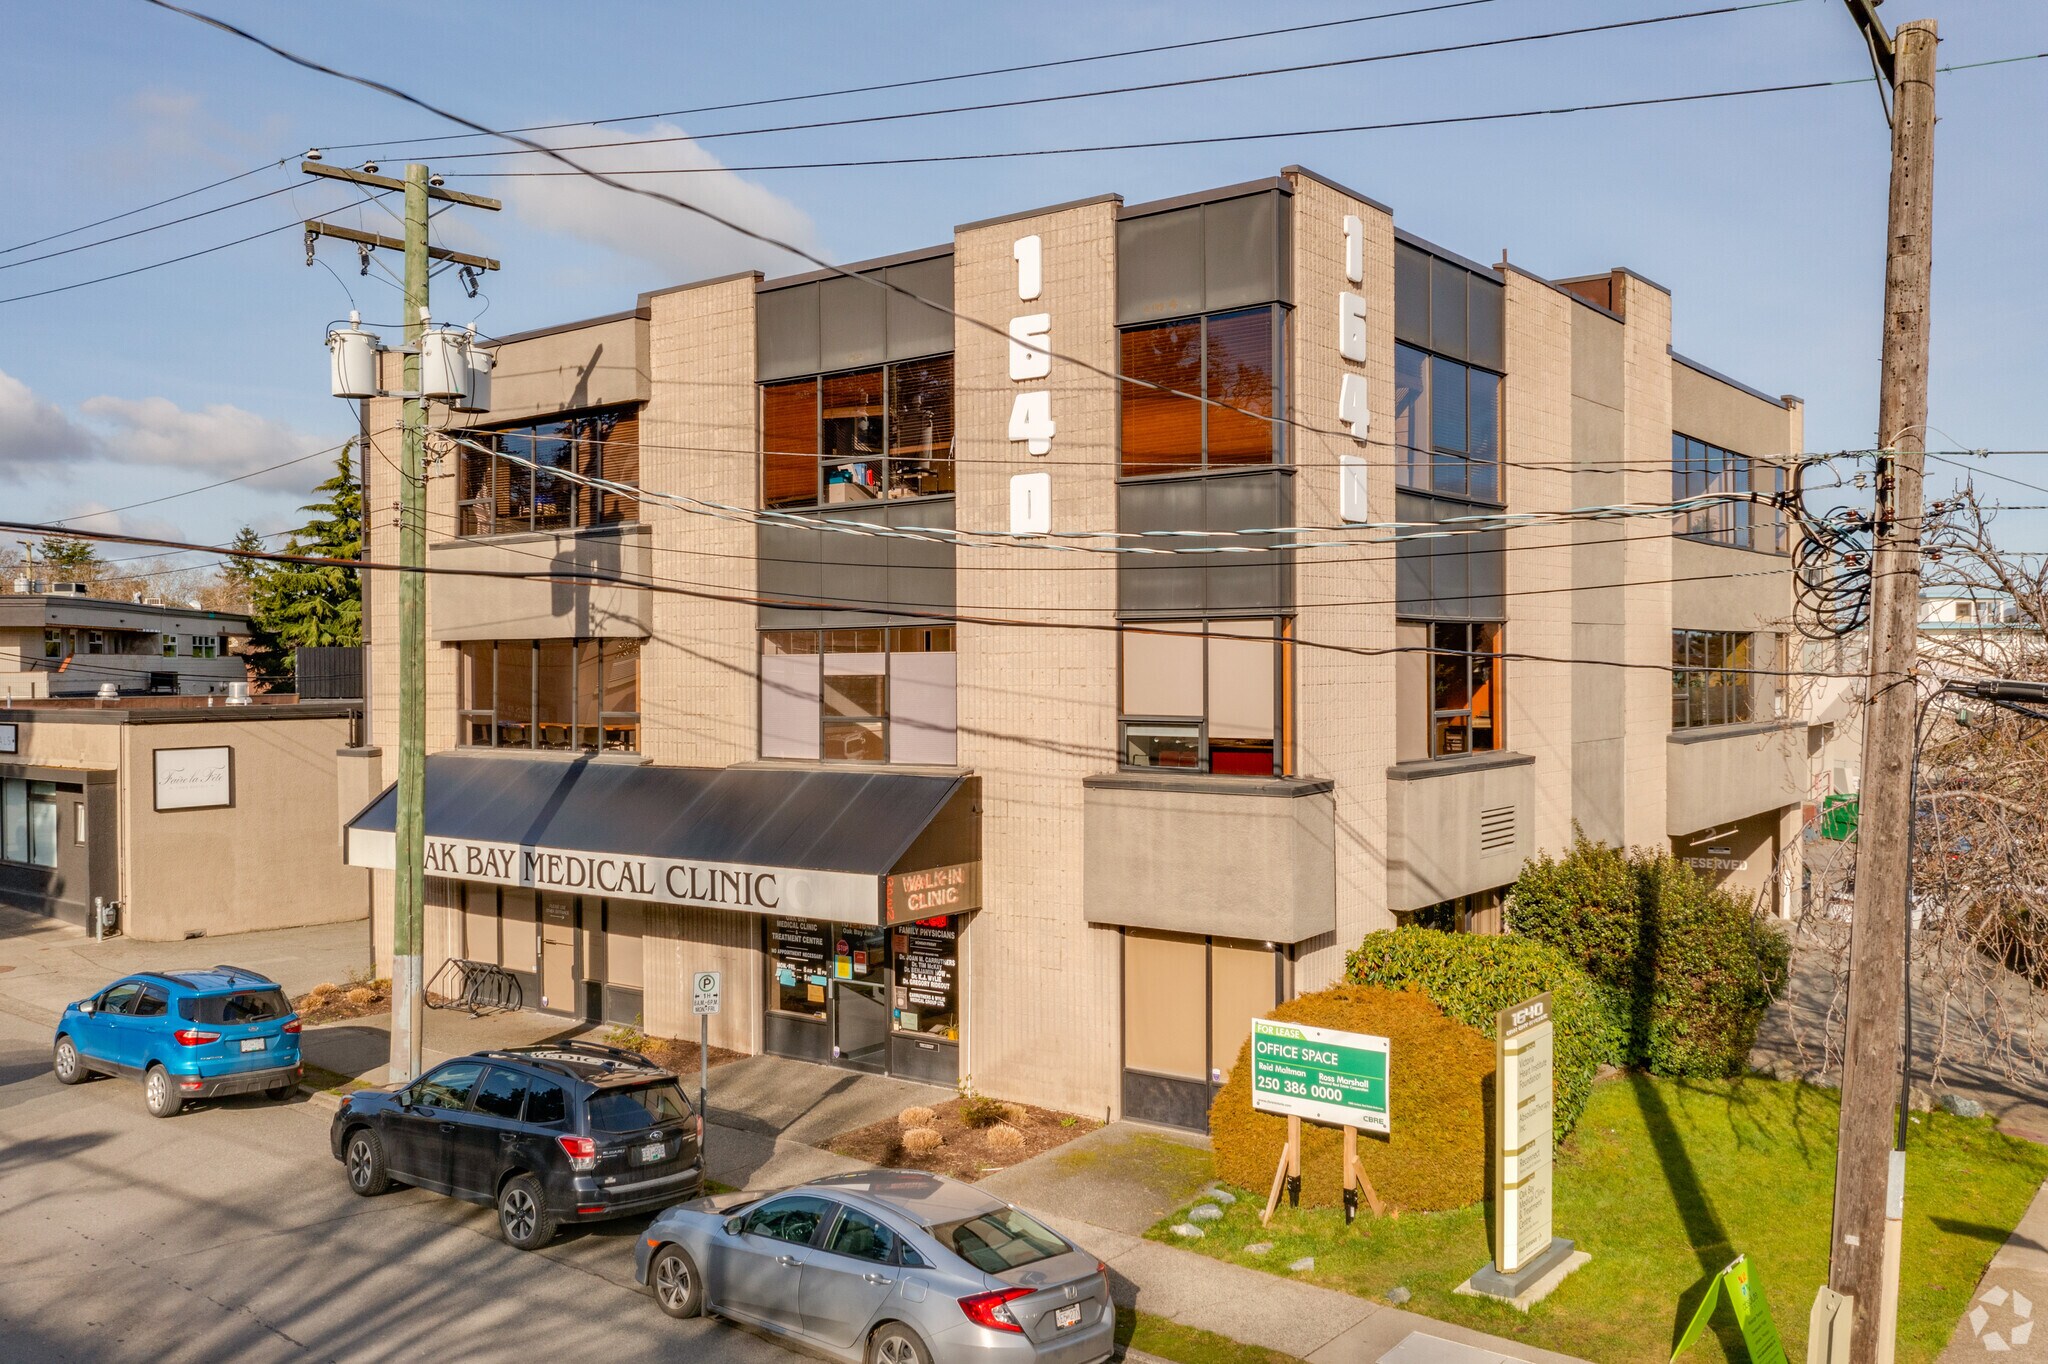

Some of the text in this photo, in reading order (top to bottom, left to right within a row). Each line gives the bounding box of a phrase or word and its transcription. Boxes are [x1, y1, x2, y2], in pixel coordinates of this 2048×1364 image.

[1339, 215, 1370, 524] 1640
[1009, 235, 1056, 538] 1640
[424, 842, 780, 909] AK BAY MEDICAL CLINIC
[902, 868, 964, 892] WALK-IN
[908, 887, 959, 910] CLINIC
[777, 920, 818, 931] MEDICAL CLINIC
[898, 926, 955, 939] FAMILY PHYSICIANS
[772, 932, 823, 945] TREATMENT CENTRE
[1511, 1002, 1543, 1026] 1640
[1257, 1024, 1300, 1039] FOR LEASE
[1257, 1041, 1338, 1066] OFFICE SPACE
[1258, 1062, 1273, 1071] Reid
[1258, 1076, 1342, 1101] 250 386 0000
[1318, 1073, 1369, 1088] Ross Marshall
[1363, 1115, 1384, 1125] CBRE
